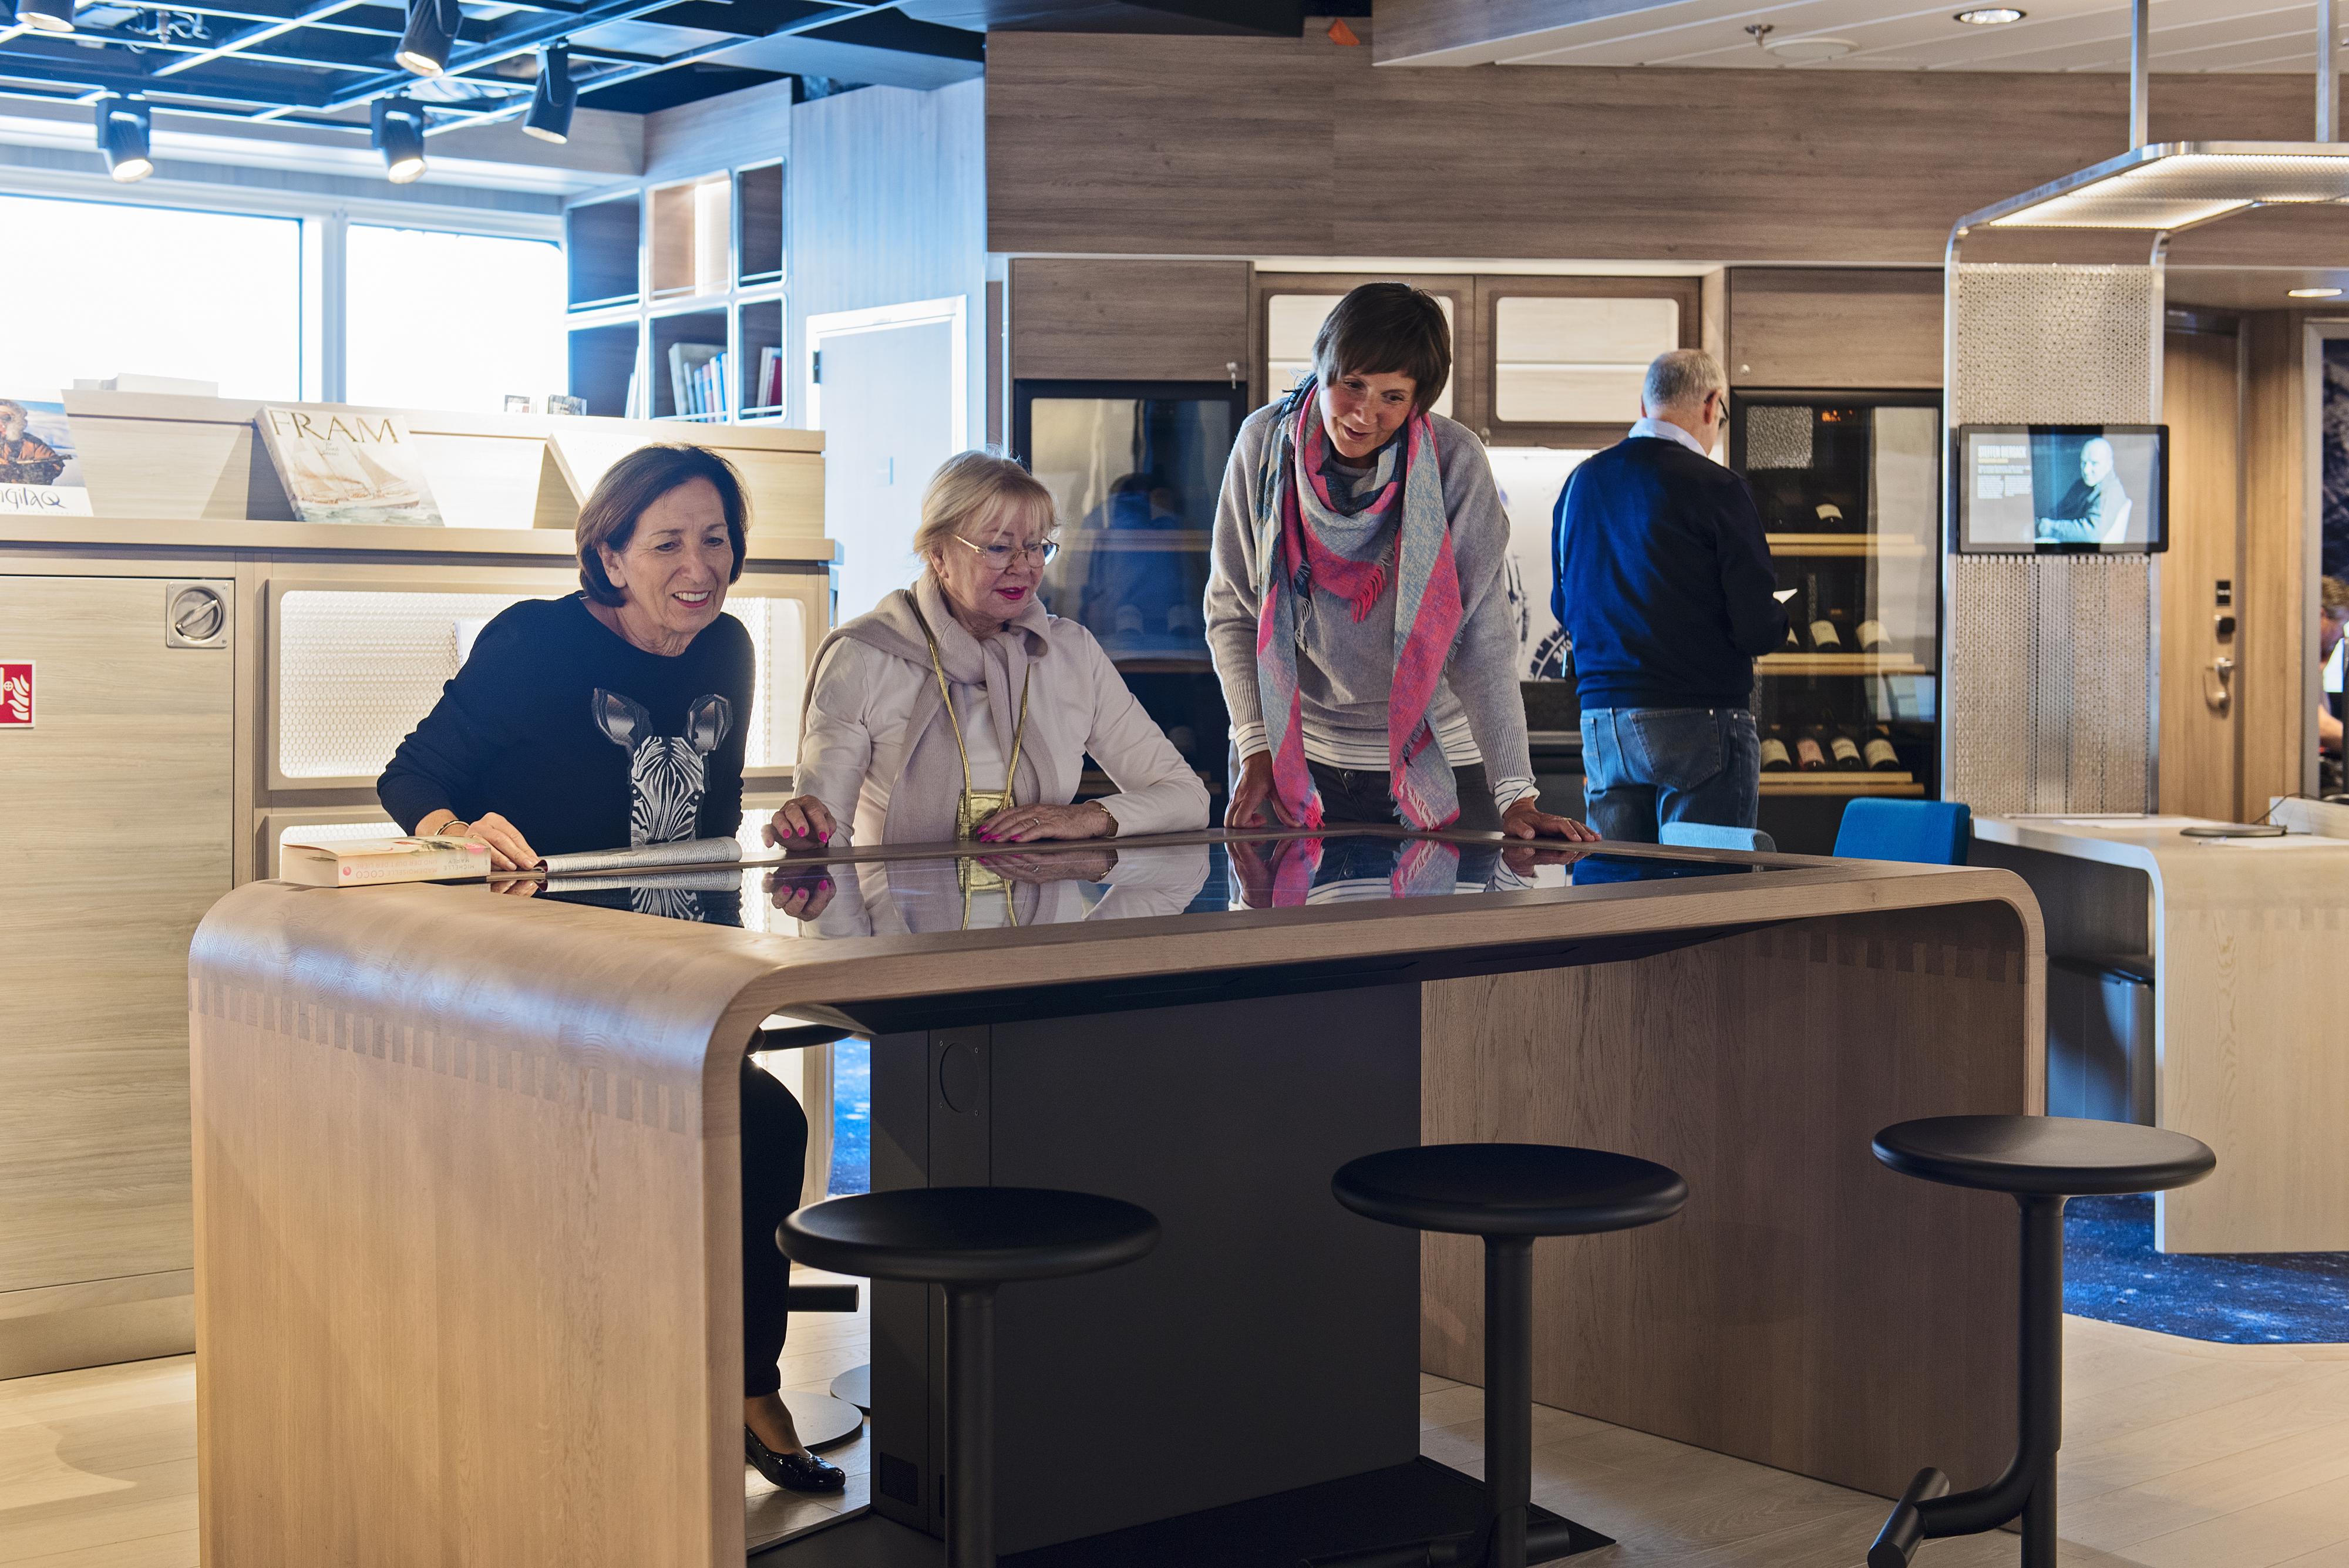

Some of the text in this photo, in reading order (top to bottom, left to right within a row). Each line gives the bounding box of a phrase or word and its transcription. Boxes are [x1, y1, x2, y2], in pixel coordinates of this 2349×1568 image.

[270, 410, 399, 443] FRAM
[356, 868, 438, 879] MADEMOISELLE COCO
